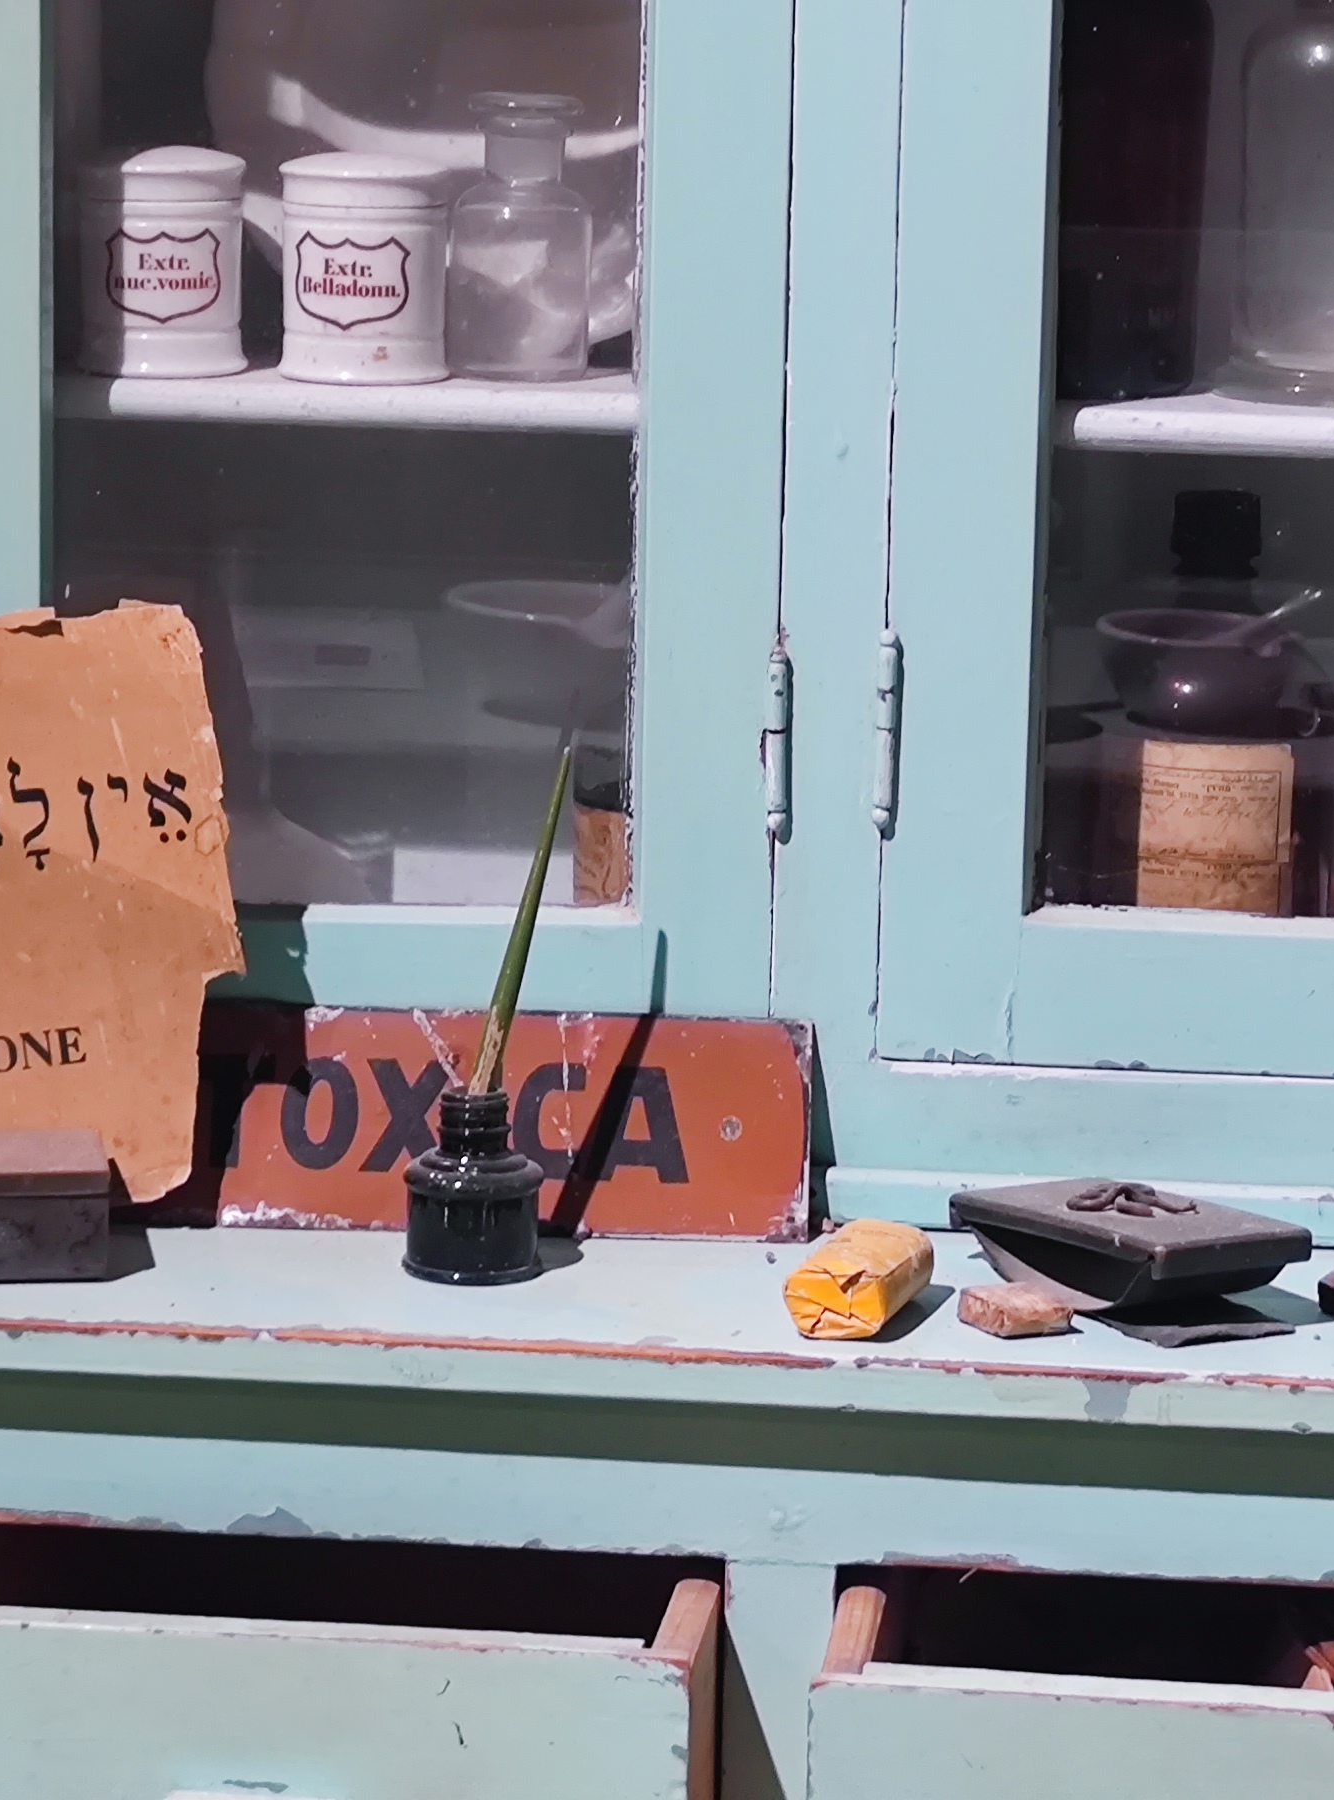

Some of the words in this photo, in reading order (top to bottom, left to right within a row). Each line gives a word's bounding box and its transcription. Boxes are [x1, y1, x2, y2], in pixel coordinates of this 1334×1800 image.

[139, 253, 190, 270] Extr.
[323, 257, 373, 278] Extr.
[302, 276, 401, 298] Belladonn.
[199, 1053, 691, 1185] TOXCA
